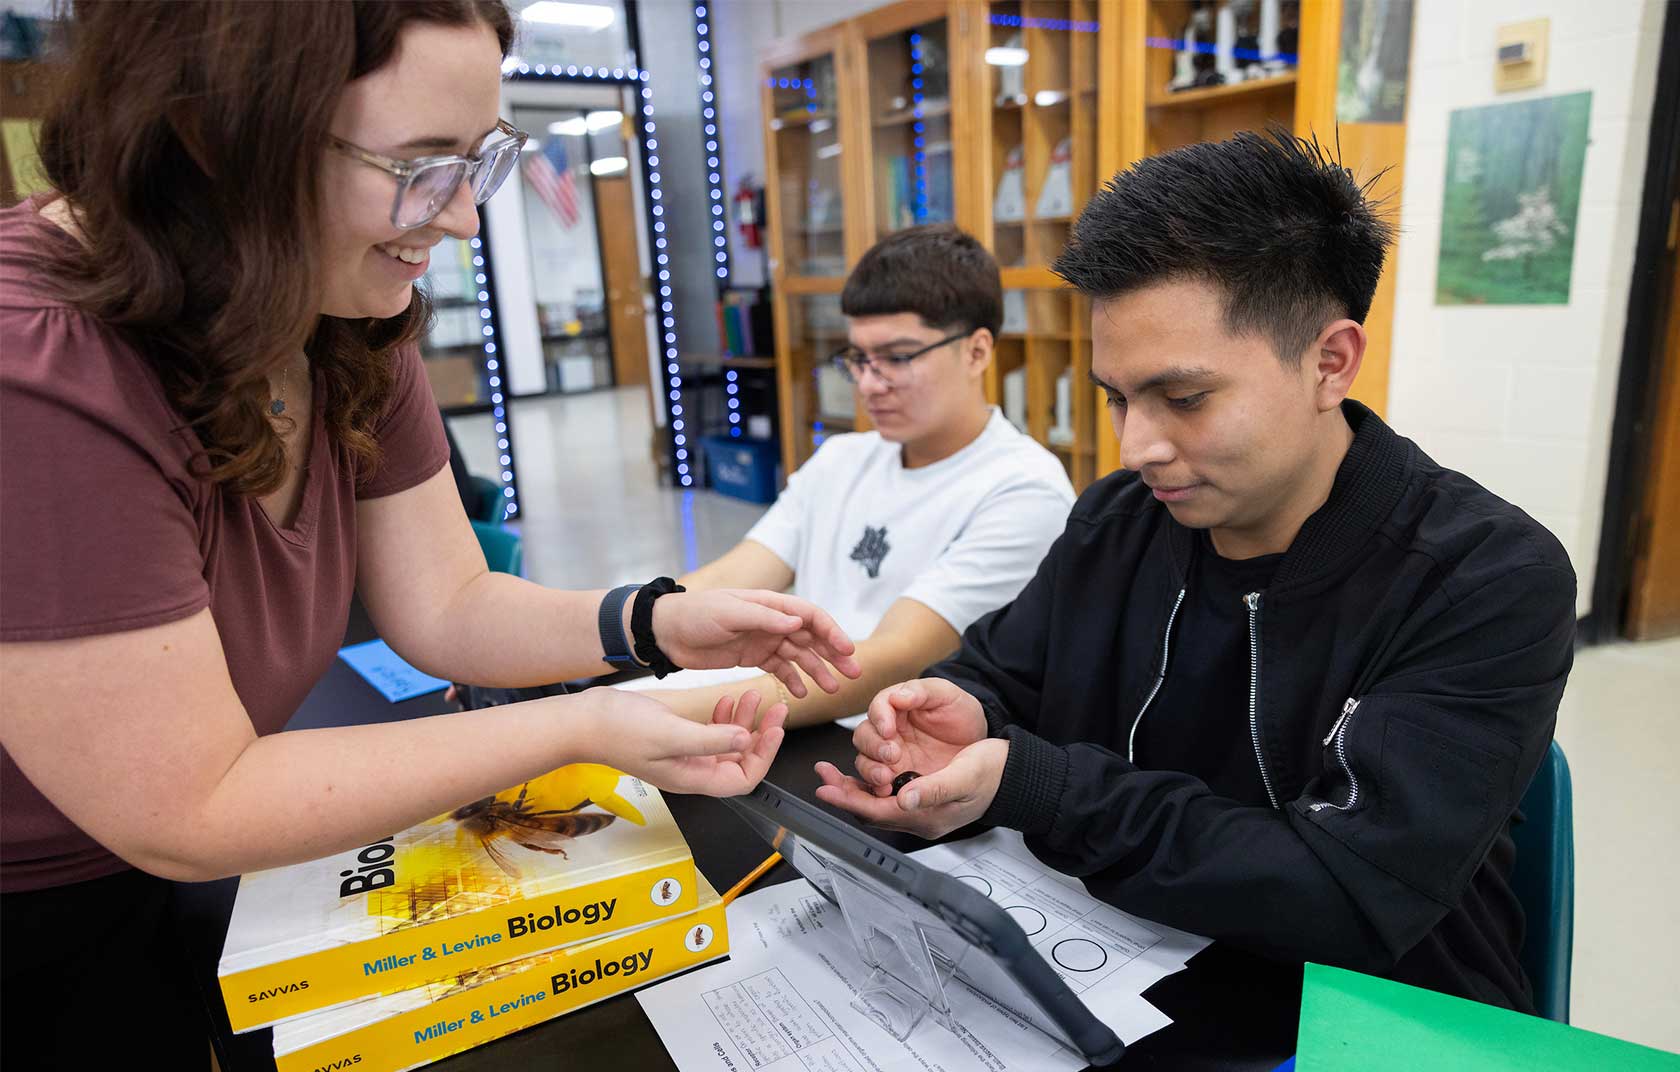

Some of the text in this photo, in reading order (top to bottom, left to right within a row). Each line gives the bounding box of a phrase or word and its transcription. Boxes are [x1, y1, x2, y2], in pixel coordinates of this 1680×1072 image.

[363, 898, 617, 976] Miller & Levine Biology
[248, 980, 310, 1003] SAVVAS
[413, 948, 653, 1044] Miller & Levine Biology
[711, 1041, 725, 1056] Cells
[721, 1055, 732, 1067] and
